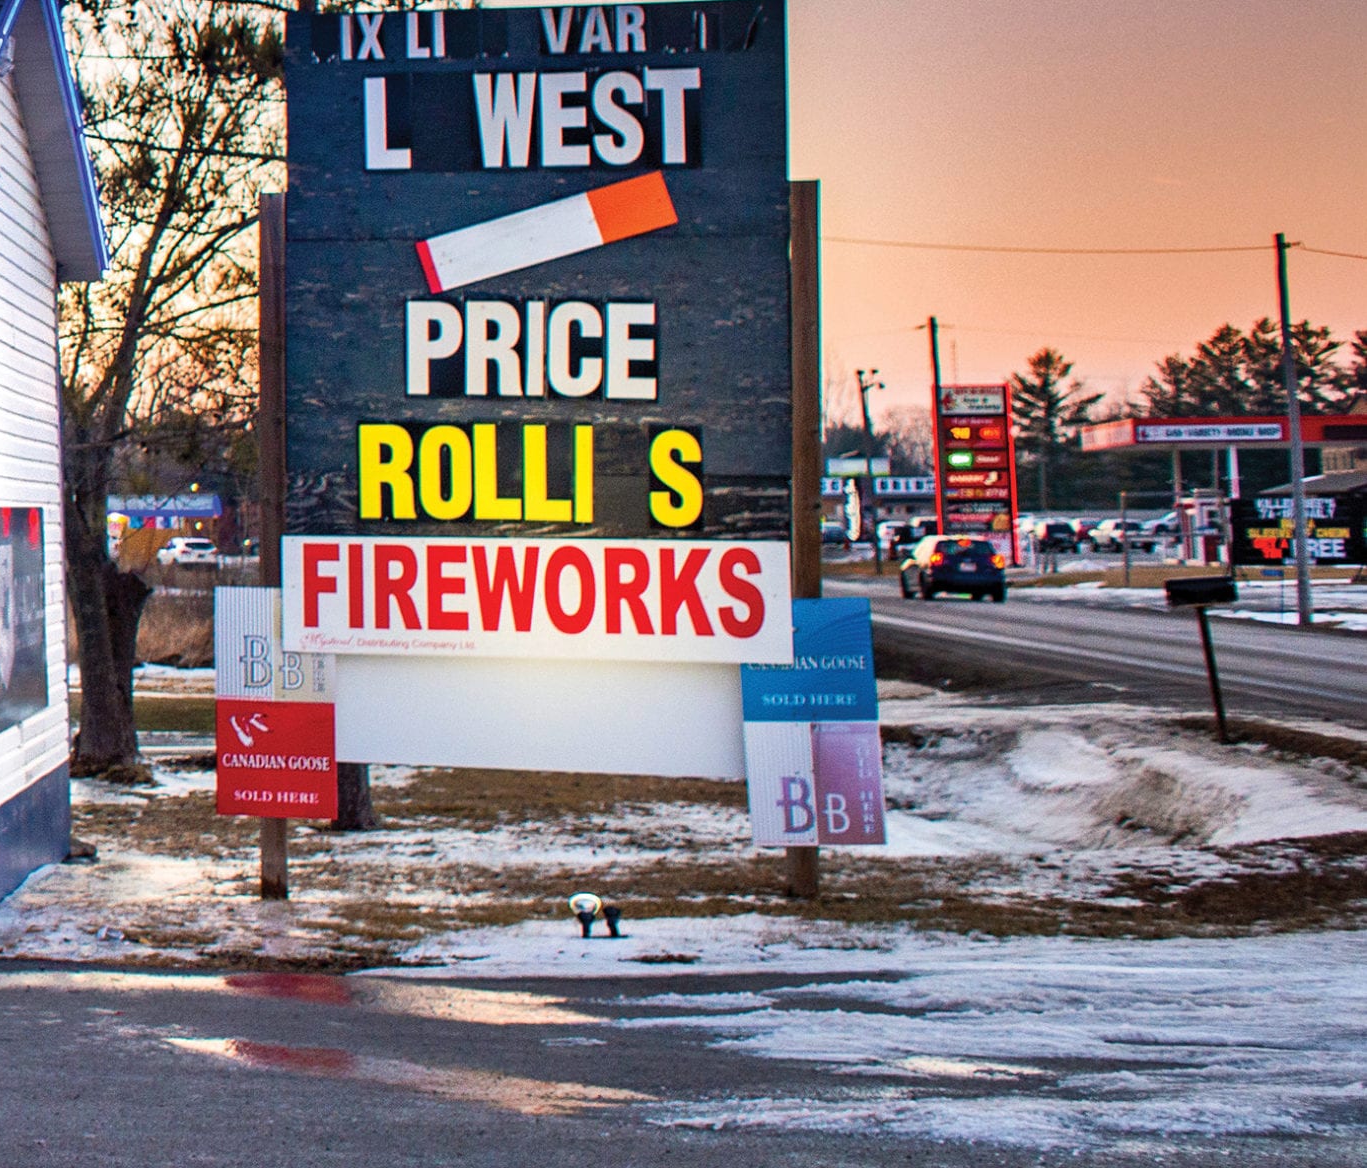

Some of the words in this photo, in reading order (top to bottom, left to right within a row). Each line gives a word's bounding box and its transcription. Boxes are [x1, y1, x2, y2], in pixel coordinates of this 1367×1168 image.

[473, 66, 701, 169] WEST
[405, 299, 658, 400] PRICE
[302, 543, 766, 638] FIREWORKS
[412, 639, 457, 651] Company
[820, 654, 866, 670] GOOSE
[761, 693, 806, 706] SOLD
[810, 693, 858, 706] HERE
[222, 752, 286, 770] CANADIAN
[288, 755, 331, 772] GOOSE
[234, 789, 273, 802] SOLD
[276, 791, 319, 804] HERE
